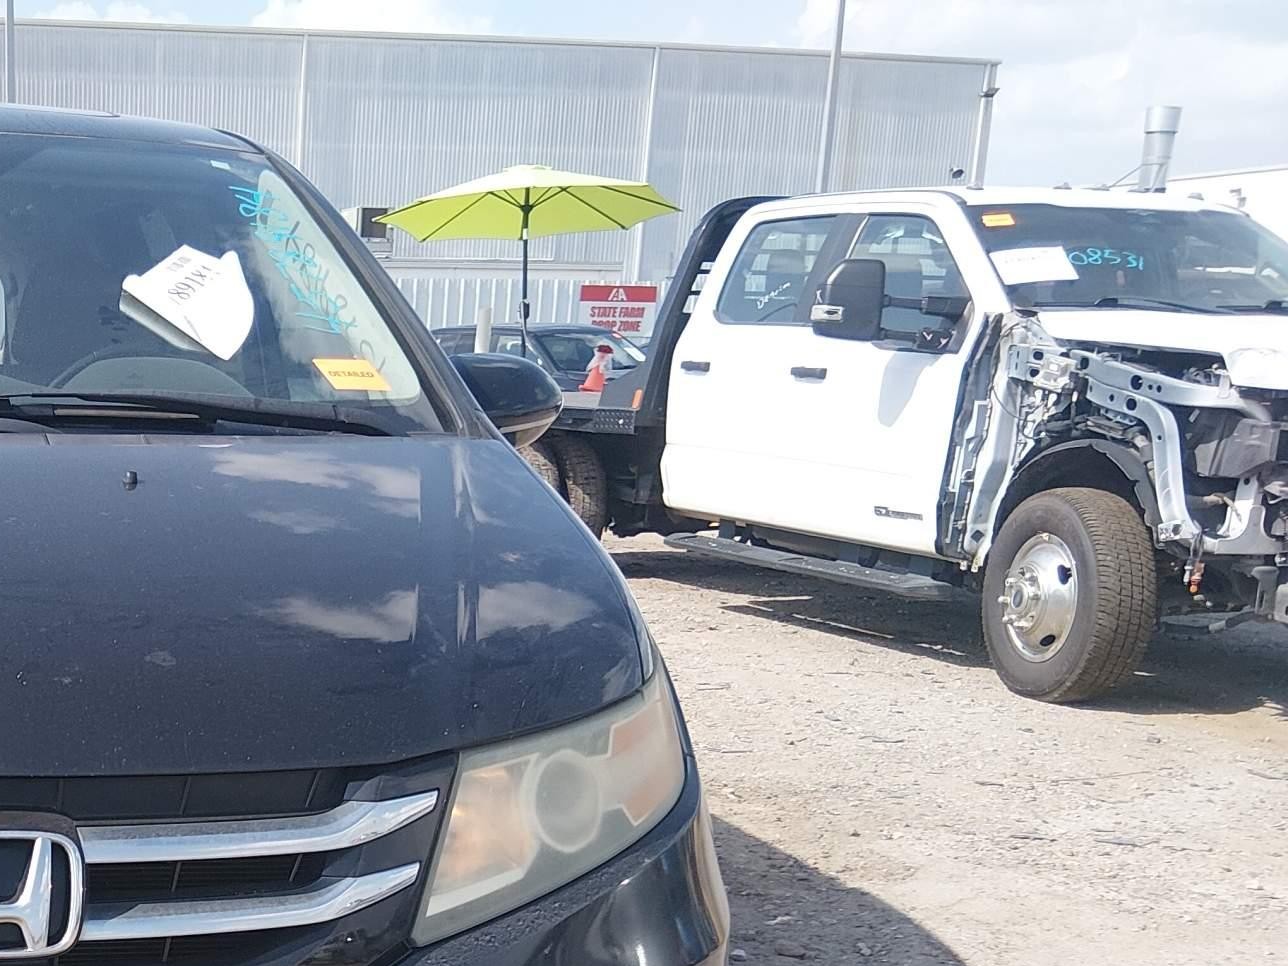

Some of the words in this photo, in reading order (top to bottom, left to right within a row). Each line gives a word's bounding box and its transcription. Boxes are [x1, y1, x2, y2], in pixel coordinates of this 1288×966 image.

[1069, 247, 1144, 270] 08531
[590, 306, 617, 318] STATE
[618, 306, 646, 318] FARM
[617, 320, 642, 332] ZONE
